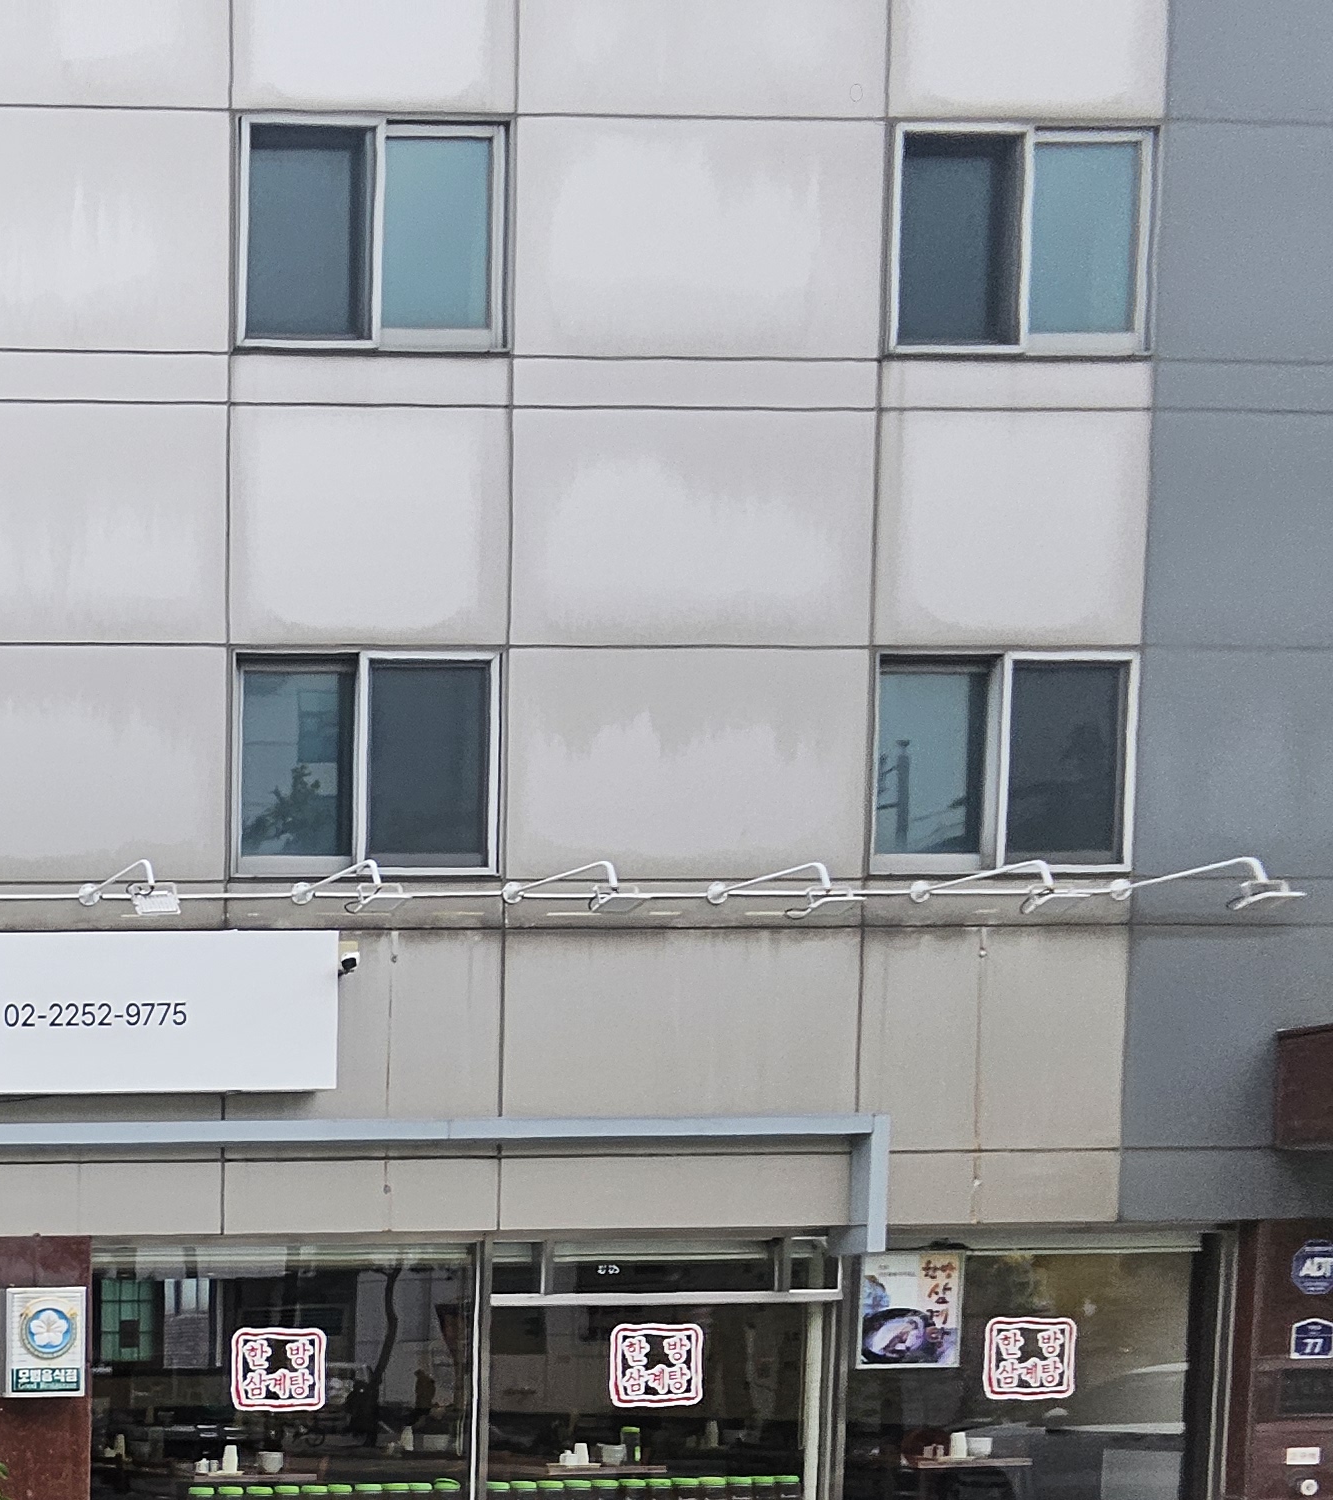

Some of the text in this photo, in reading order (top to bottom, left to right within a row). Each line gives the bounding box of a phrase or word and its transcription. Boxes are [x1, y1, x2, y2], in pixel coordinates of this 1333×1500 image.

[4, 1002, 187, 1027] 02-2252-9775
[1302, 1338, 1324, 1353] 77
[245, 1372, 311, 1397] 삼계탕
[624, 1366, 688, 1393] 삼계탕
[997, 1360, 1063, 1385] 삼계탕
